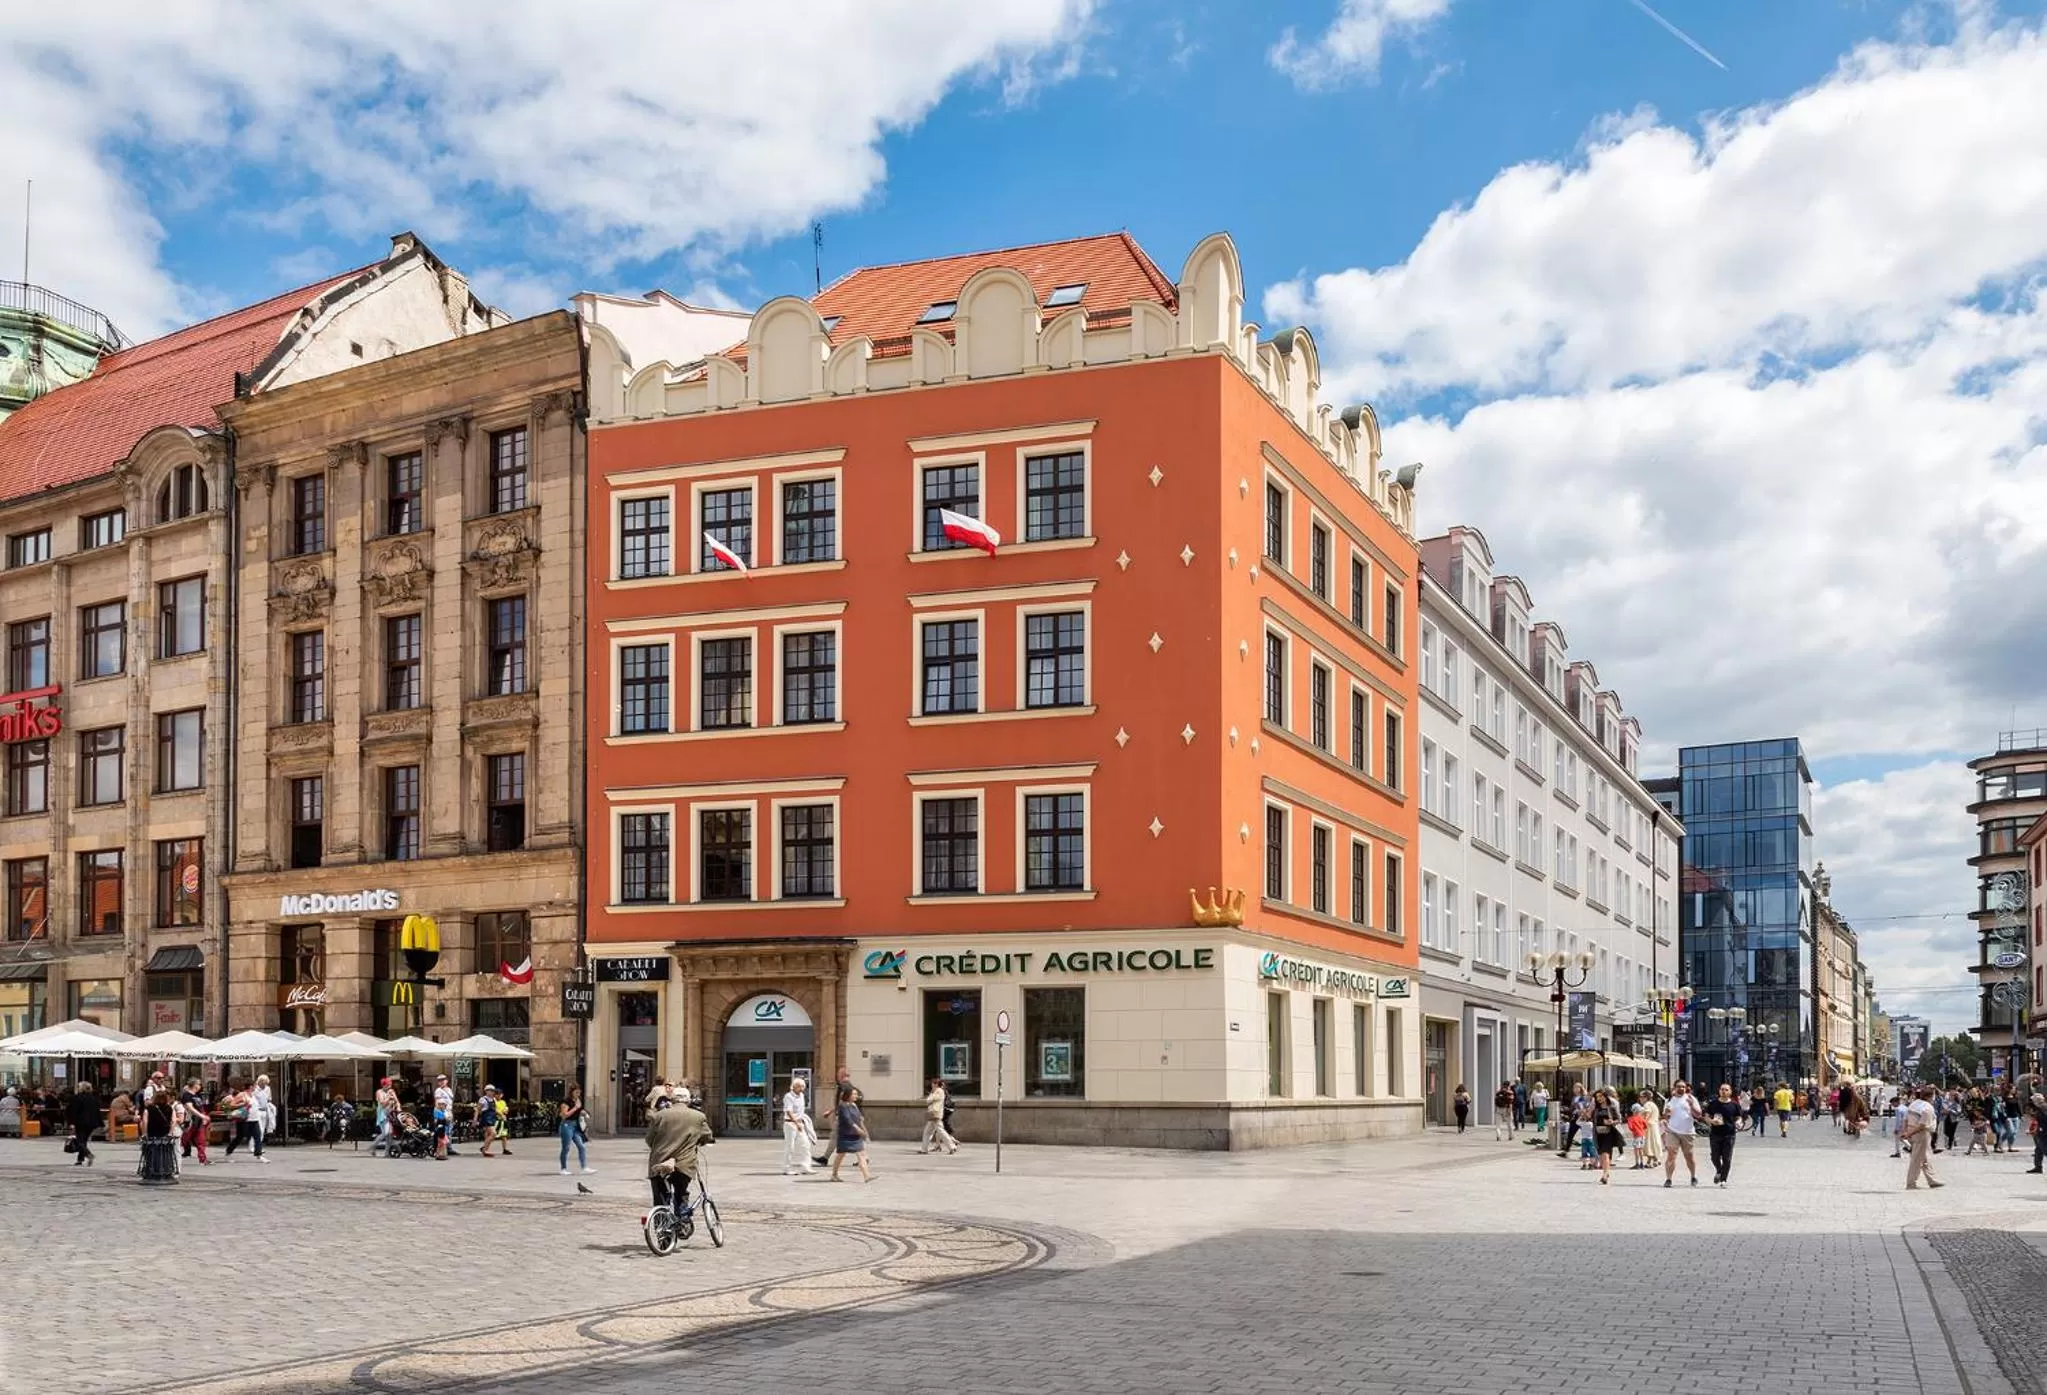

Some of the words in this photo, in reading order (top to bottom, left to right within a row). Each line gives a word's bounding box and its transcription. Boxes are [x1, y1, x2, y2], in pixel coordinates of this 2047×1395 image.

[281, 889, 399, 916] McDonald's
[617, 970, 649, 980] SHOW
[915, 950, 1032, 976] CRÉDIT
[1043, 948, 1214, 973] AGRICOLE
[1281, 958, 1323, 982] CRÉDIT
[1325, 970, 1375, 994] AGRICOLE
